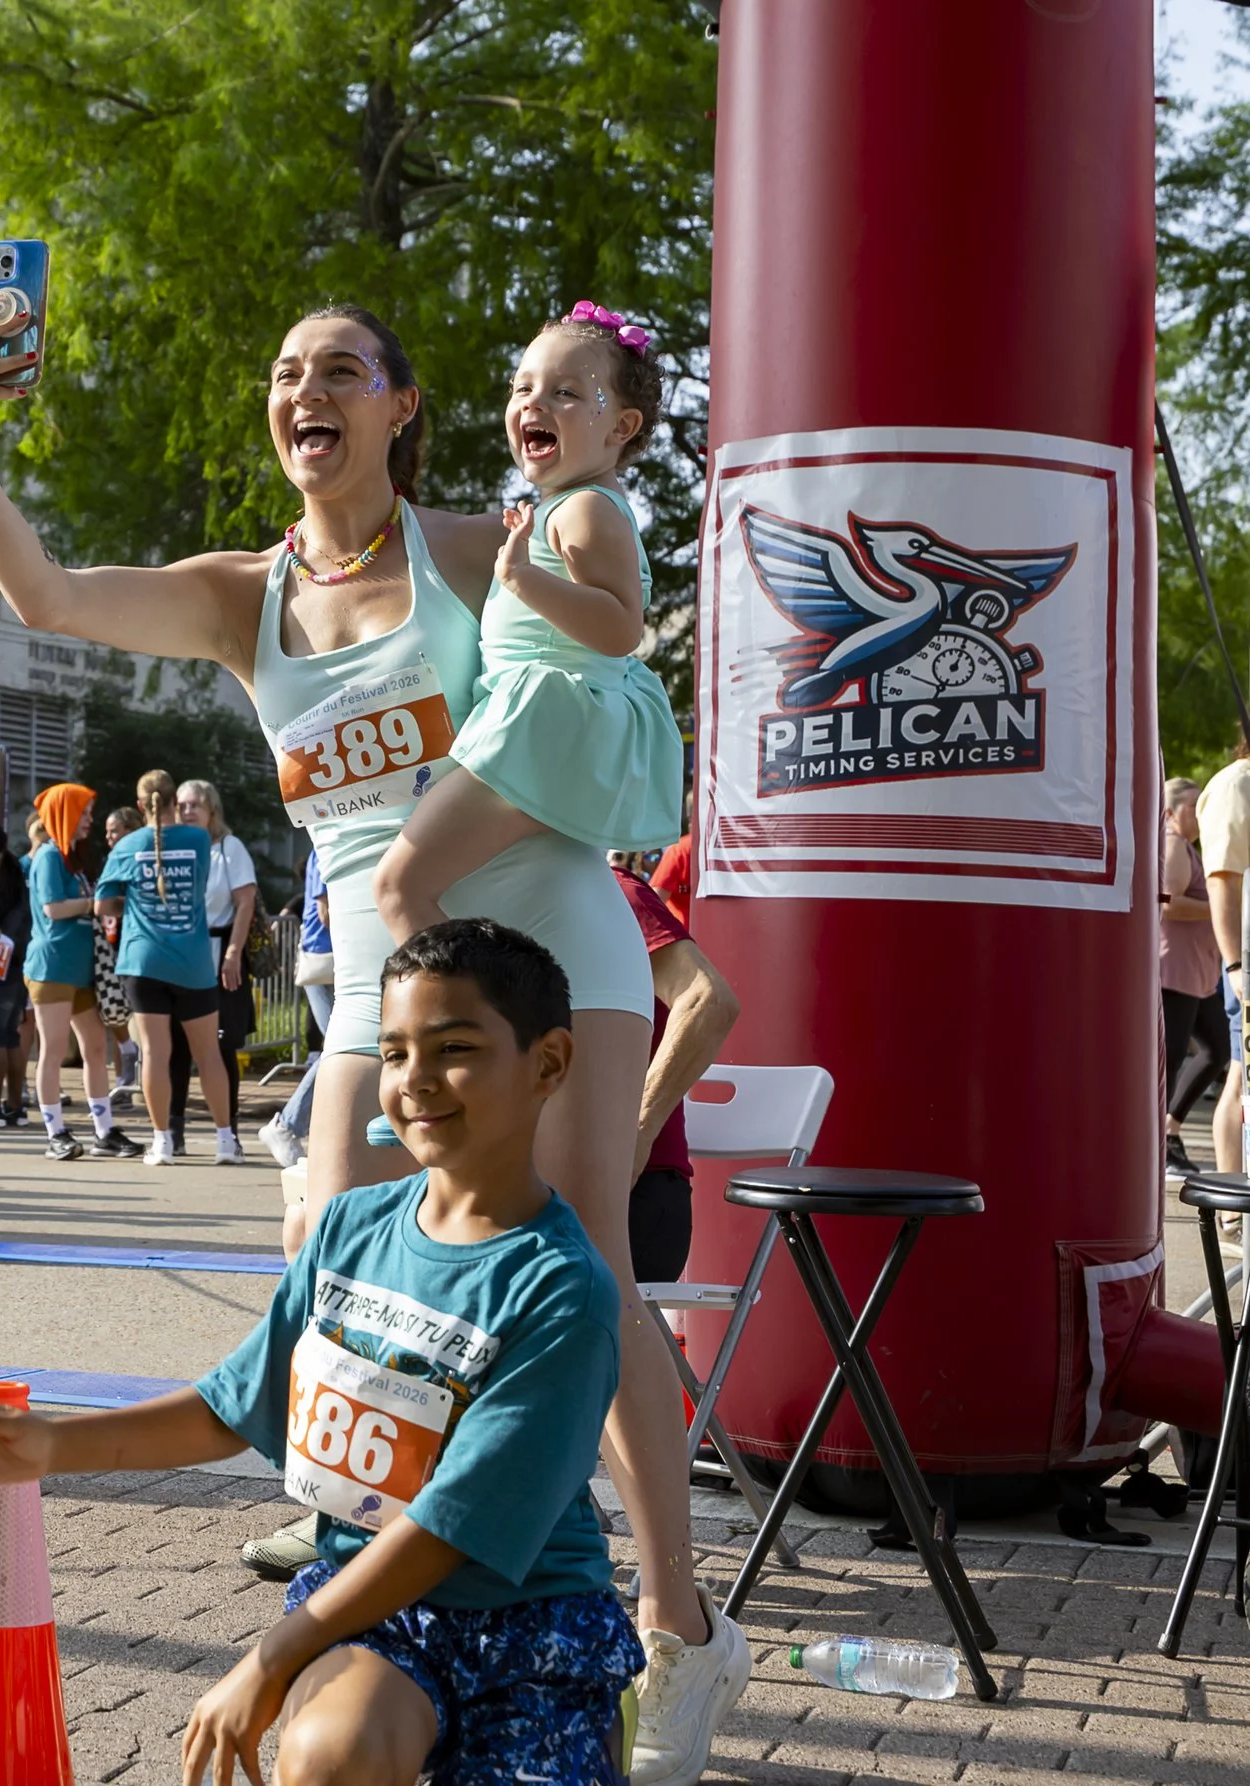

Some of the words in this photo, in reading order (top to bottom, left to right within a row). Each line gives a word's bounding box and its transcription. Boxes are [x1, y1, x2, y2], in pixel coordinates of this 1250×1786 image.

[287, 707, 321, 730] Courir
[323, 701, 338, 714] du
[340, 683, 388, 709] Festival
[390, 673, 421, 692] 2026
[303, 708, 424, 789] 389
[765, 698, 1036, 763] PELICAN
[784, 756, 876, 781] TIMING
[885, 746, 1016, 770] SERVICES
[403, 1314, 420, 1332] SI
[417, 1320, 450, 1344] TU
[442, 1332, 491, 1365] PEUX
[335, 1357, 390, 1393] Festival
[392, 1381, 430, 1407] 2026
[287, 1369, 399, 1486] 386
